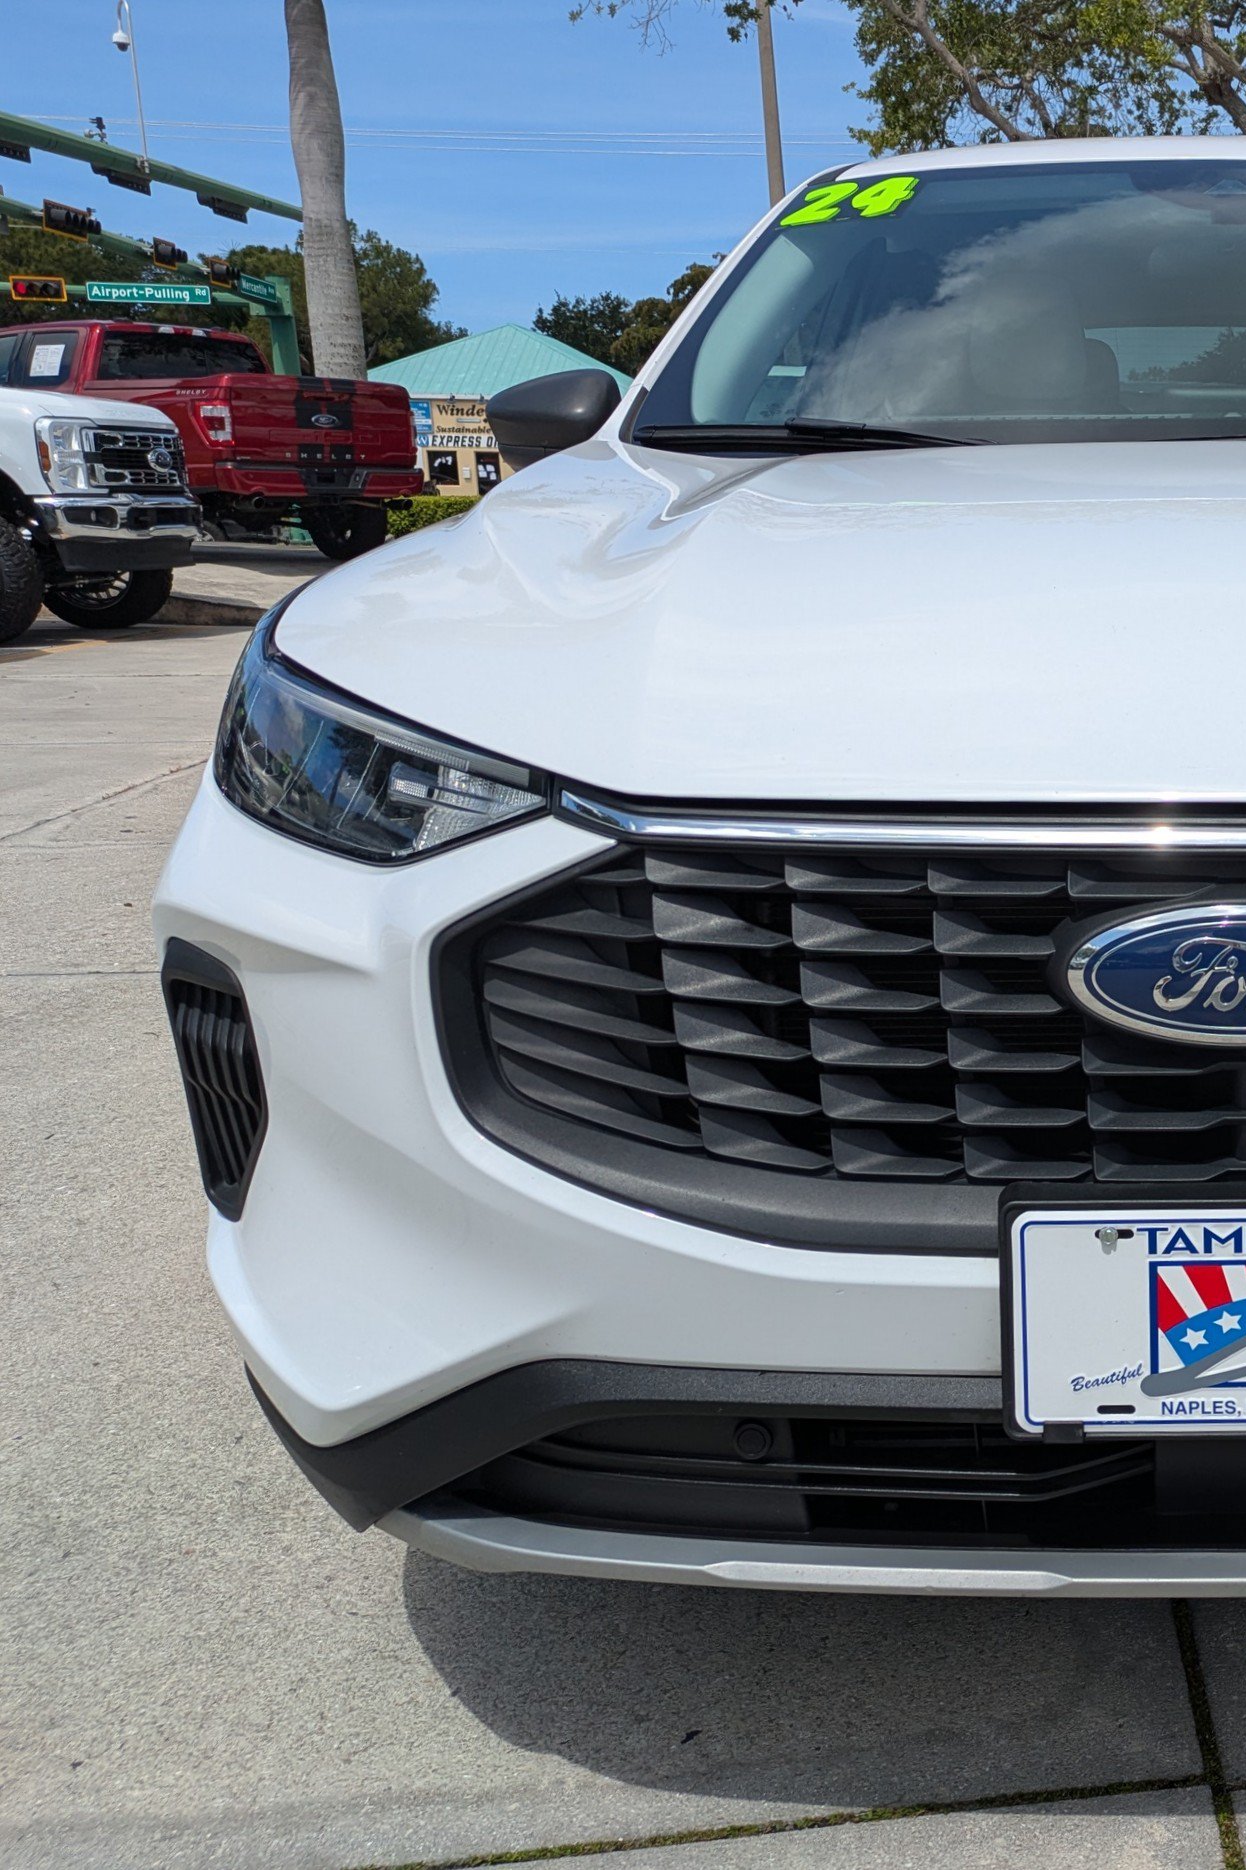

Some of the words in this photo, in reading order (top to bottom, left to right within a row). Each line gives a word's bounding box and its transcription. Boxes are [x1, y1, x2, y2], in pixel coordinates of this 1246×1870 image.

[780, 176, 920, 226] 24
[91, 286, 190, 302] Airport-Pulling
[195, 288, 207, 296] Rd
[436, 425, 492, 434] Sustainable
[431, 435, 482, 447] EXPRESS
[285, 452, 366, 460] SHELBY
[1071, 1363, 1144, 1392] Beautiful
[1161, 1401, 1242, 1416] NAPLES,
